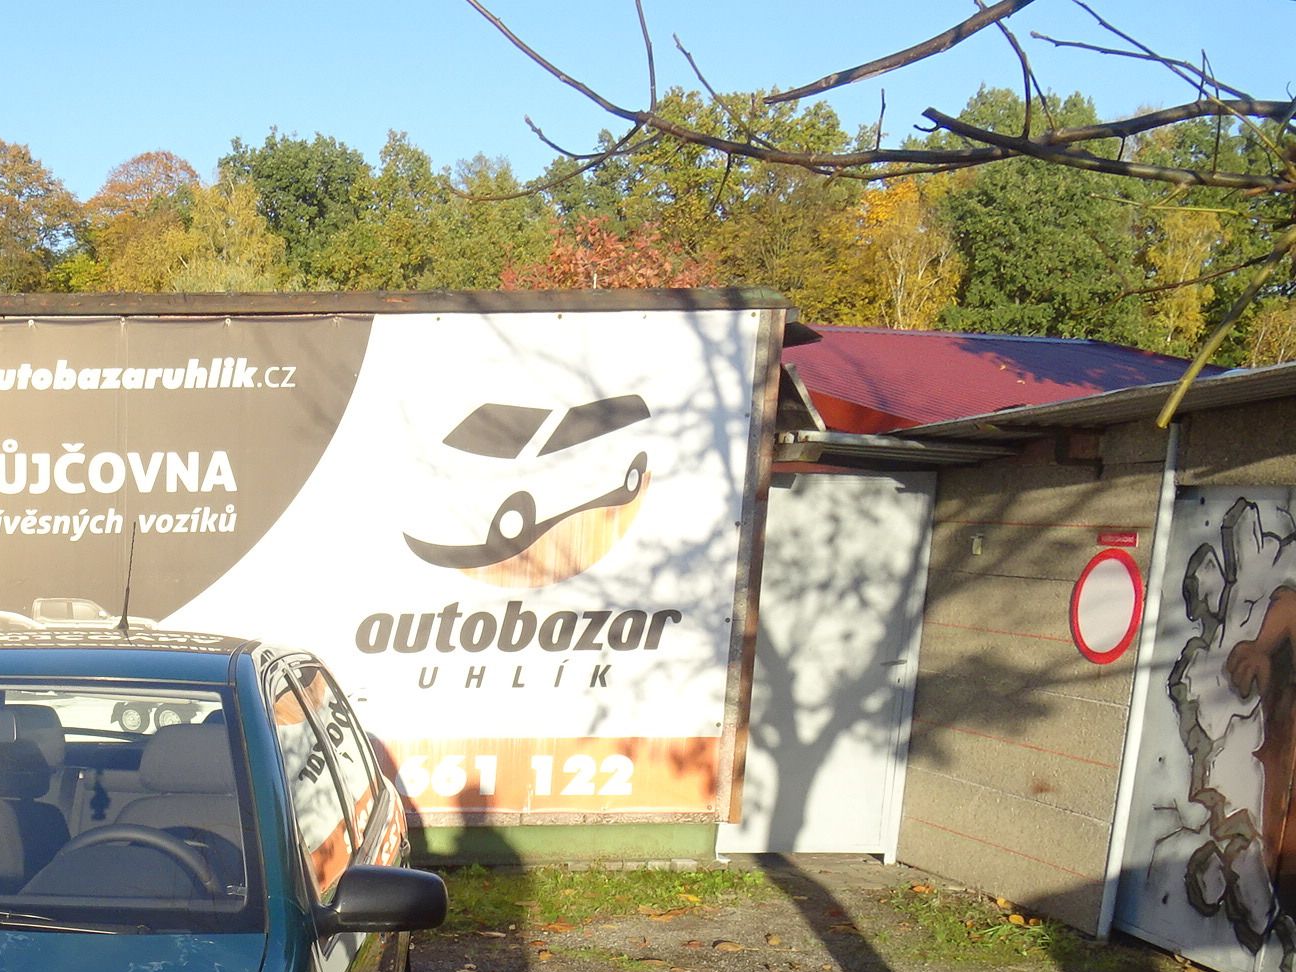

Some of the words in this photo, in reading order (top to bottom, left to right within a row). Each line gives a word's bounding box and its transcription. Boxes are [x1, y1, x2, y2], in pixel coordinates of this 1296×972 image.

[138, 504, 238, 534] vozíků
[355, 601, 682, 654] autobazar
[418, 658, 613, 689] UHLÍK
[395, 754, 497, 798] 661
[531, 754, 634, 796] 122
